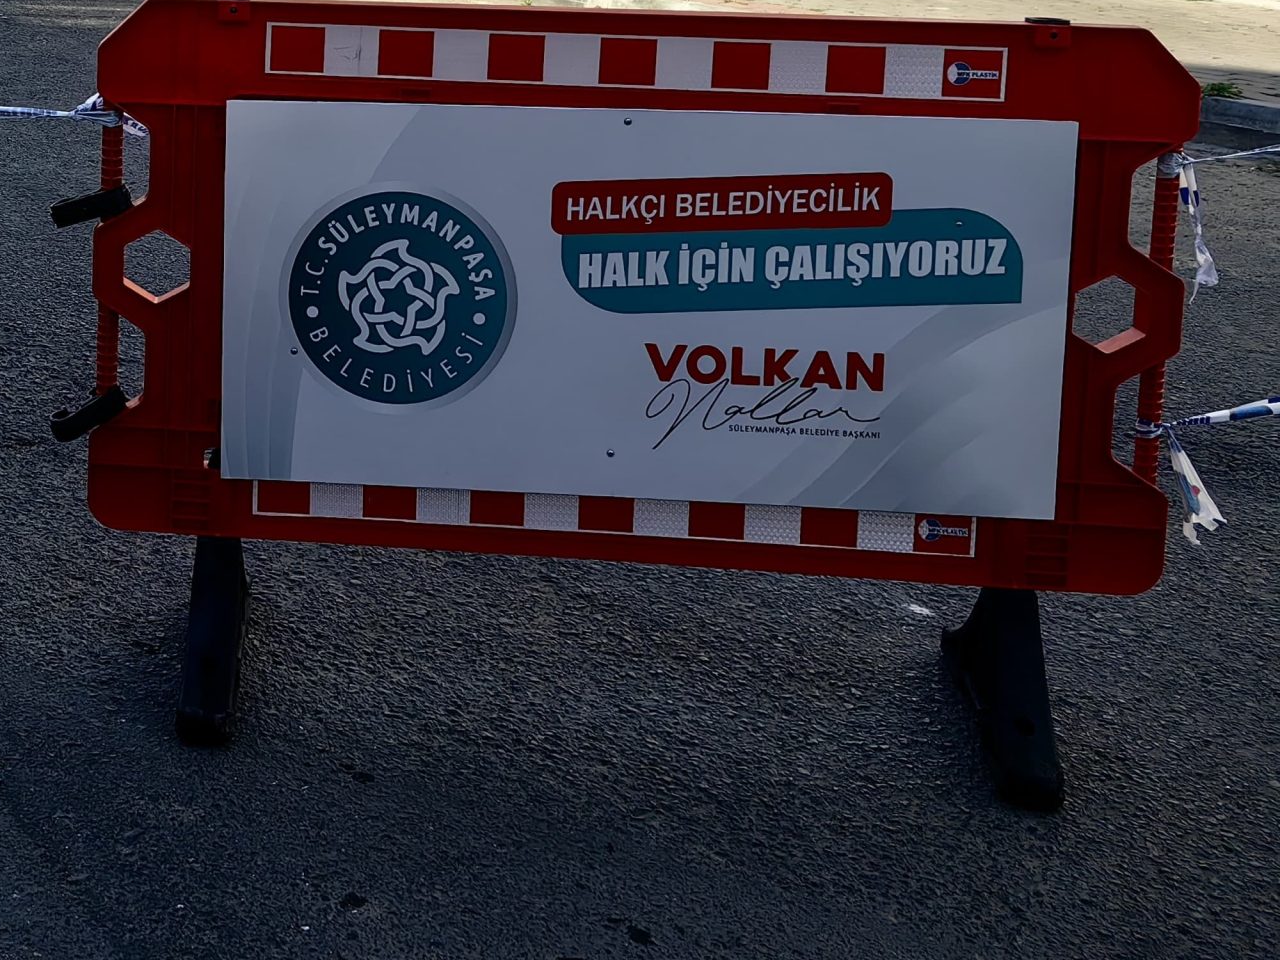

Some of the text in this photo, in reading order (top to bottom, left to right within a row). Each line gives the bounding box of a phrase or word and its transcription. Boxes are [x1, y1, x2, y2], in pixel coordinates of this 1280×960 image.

[566, 182, 881, 224] HALKÇI BELEDİYECİLİK
[318, 202, 496, 301] SÜLEYMANPAŞA
[578, 238, 1008, 291] HALK İÇİN ÇALIŞIYORUZ
[309, 326, 484, 393] BELEDİYESİ
[644, 343, 886, 392] VOLKAN
[728, 424, 881, 439] SÜLEYMANPAŞA BELEDİYE BAŞKANI
